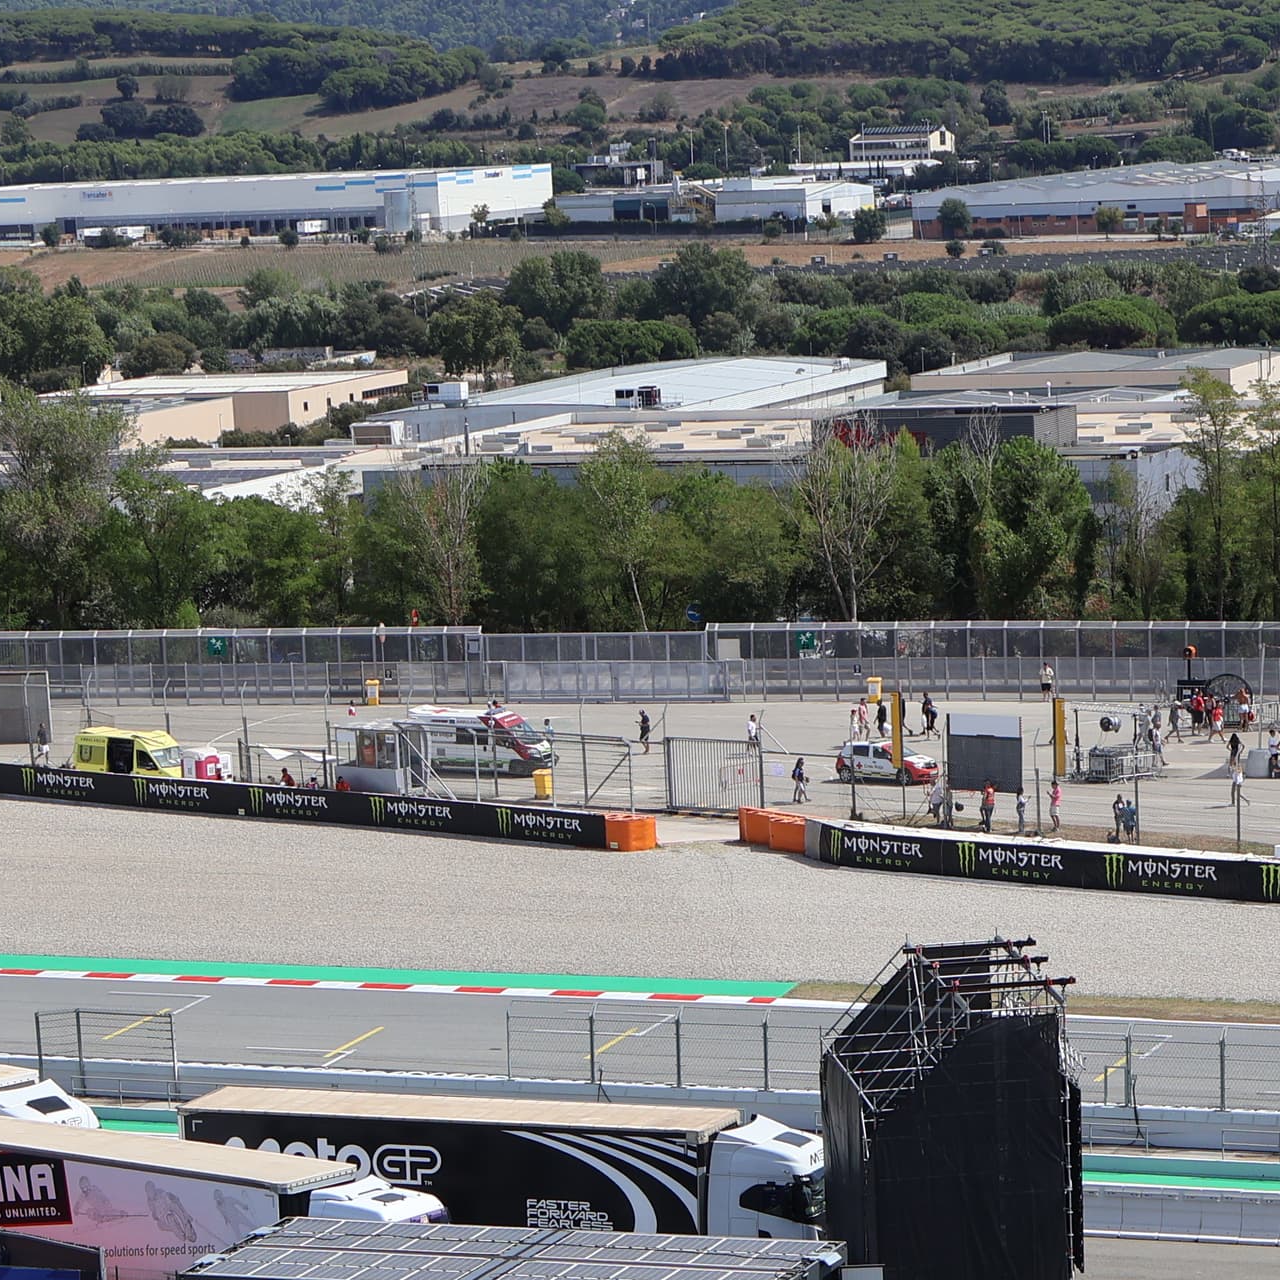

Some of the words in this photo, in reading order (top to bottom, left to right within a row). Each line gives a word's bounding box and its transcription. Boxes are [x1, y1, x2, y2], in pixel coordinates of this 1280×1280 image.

[37, 772, 94, 789] MONSTER
[149, 782, 209, 799] MONSTER
[266, 791, 327, 808] MONSTER
[387, 801, 452, 819] MONSTER
[514, 813, 581, 831] MONSTER
[844, 836, 922, 858] MONSTER
[856, 856, 911, 866] ENERGY
[979, 847, 1063, 869] MONSTER
[992, 868, 1050, 879] ENERGY
[1128, 859, 1217, 880] MONSTER
[1142, 880, 1204, 891] ENERGY
[527, 1199, 590, 1211] FASTER
[527, 1208, 609, 1222] FORWARD
[527, 1218, 614, 1231] FEARLESS
[104, 1244, 144, 1257] solutions
[146, 1244, 158, 1256] for
[160, 1243, 186, 1258] speed
[188, 1242, 216, 1257] sports
